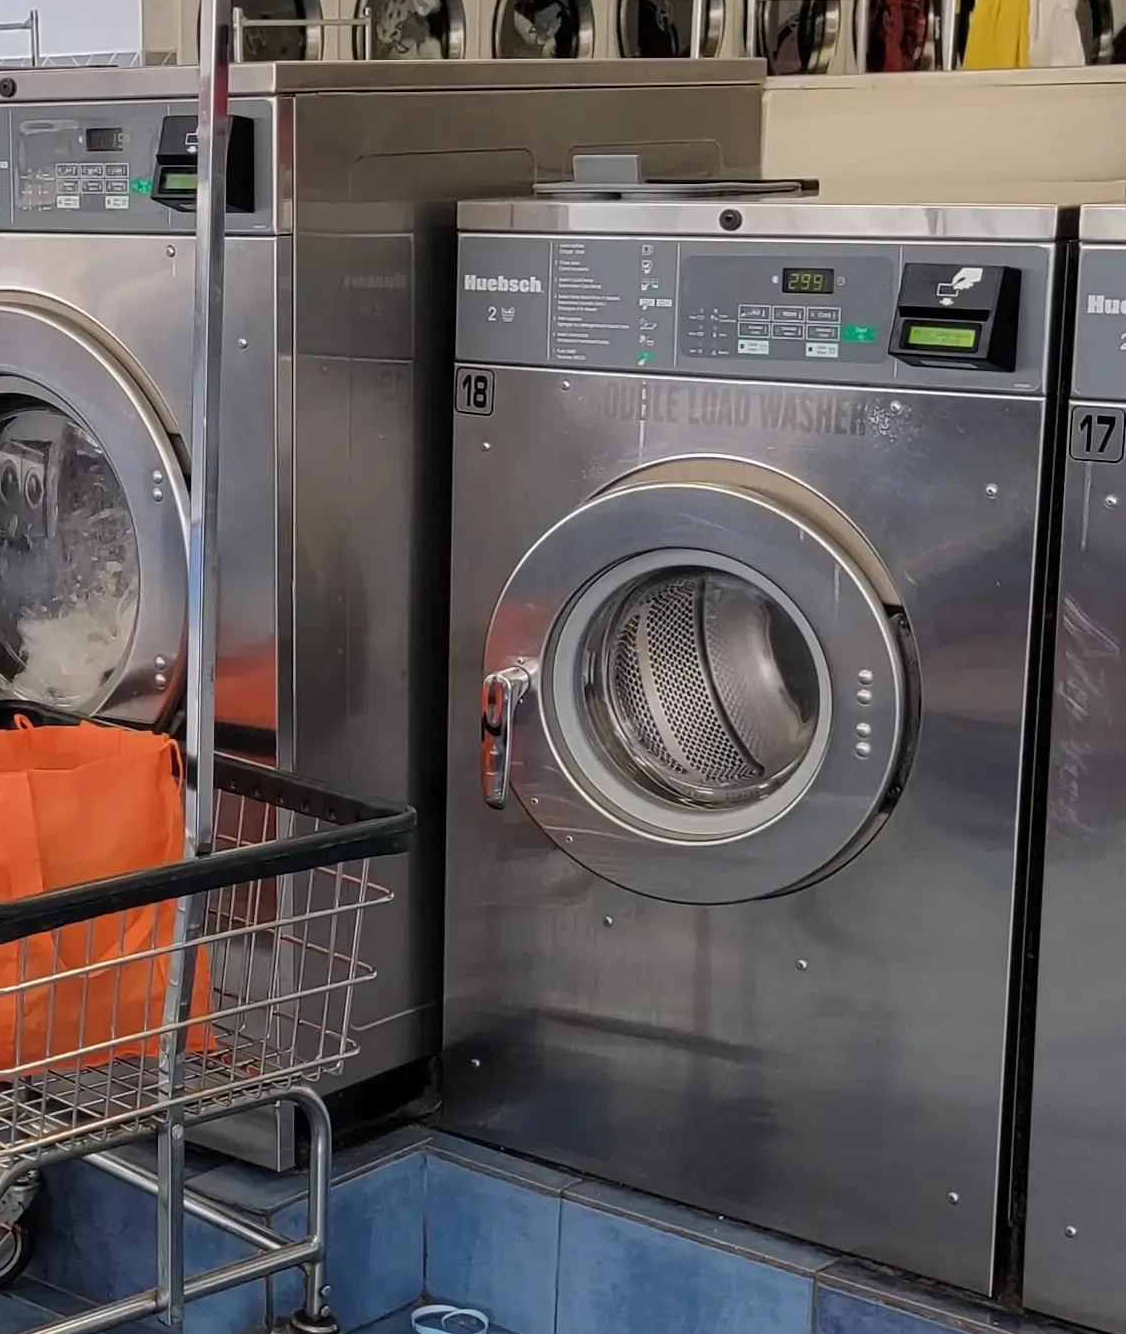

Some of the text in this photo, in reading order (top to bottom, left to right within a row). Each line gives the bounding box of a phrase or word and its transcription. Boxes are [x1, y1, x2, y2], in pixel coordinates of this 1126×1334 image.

[464, 274, 543, 294] Huebsch
[788, 273, 824, 291] 299
[487, 305, 498, 322] 2
[462, 374, 489, 409] 18
[1079, 414, 1117, 454] 17
